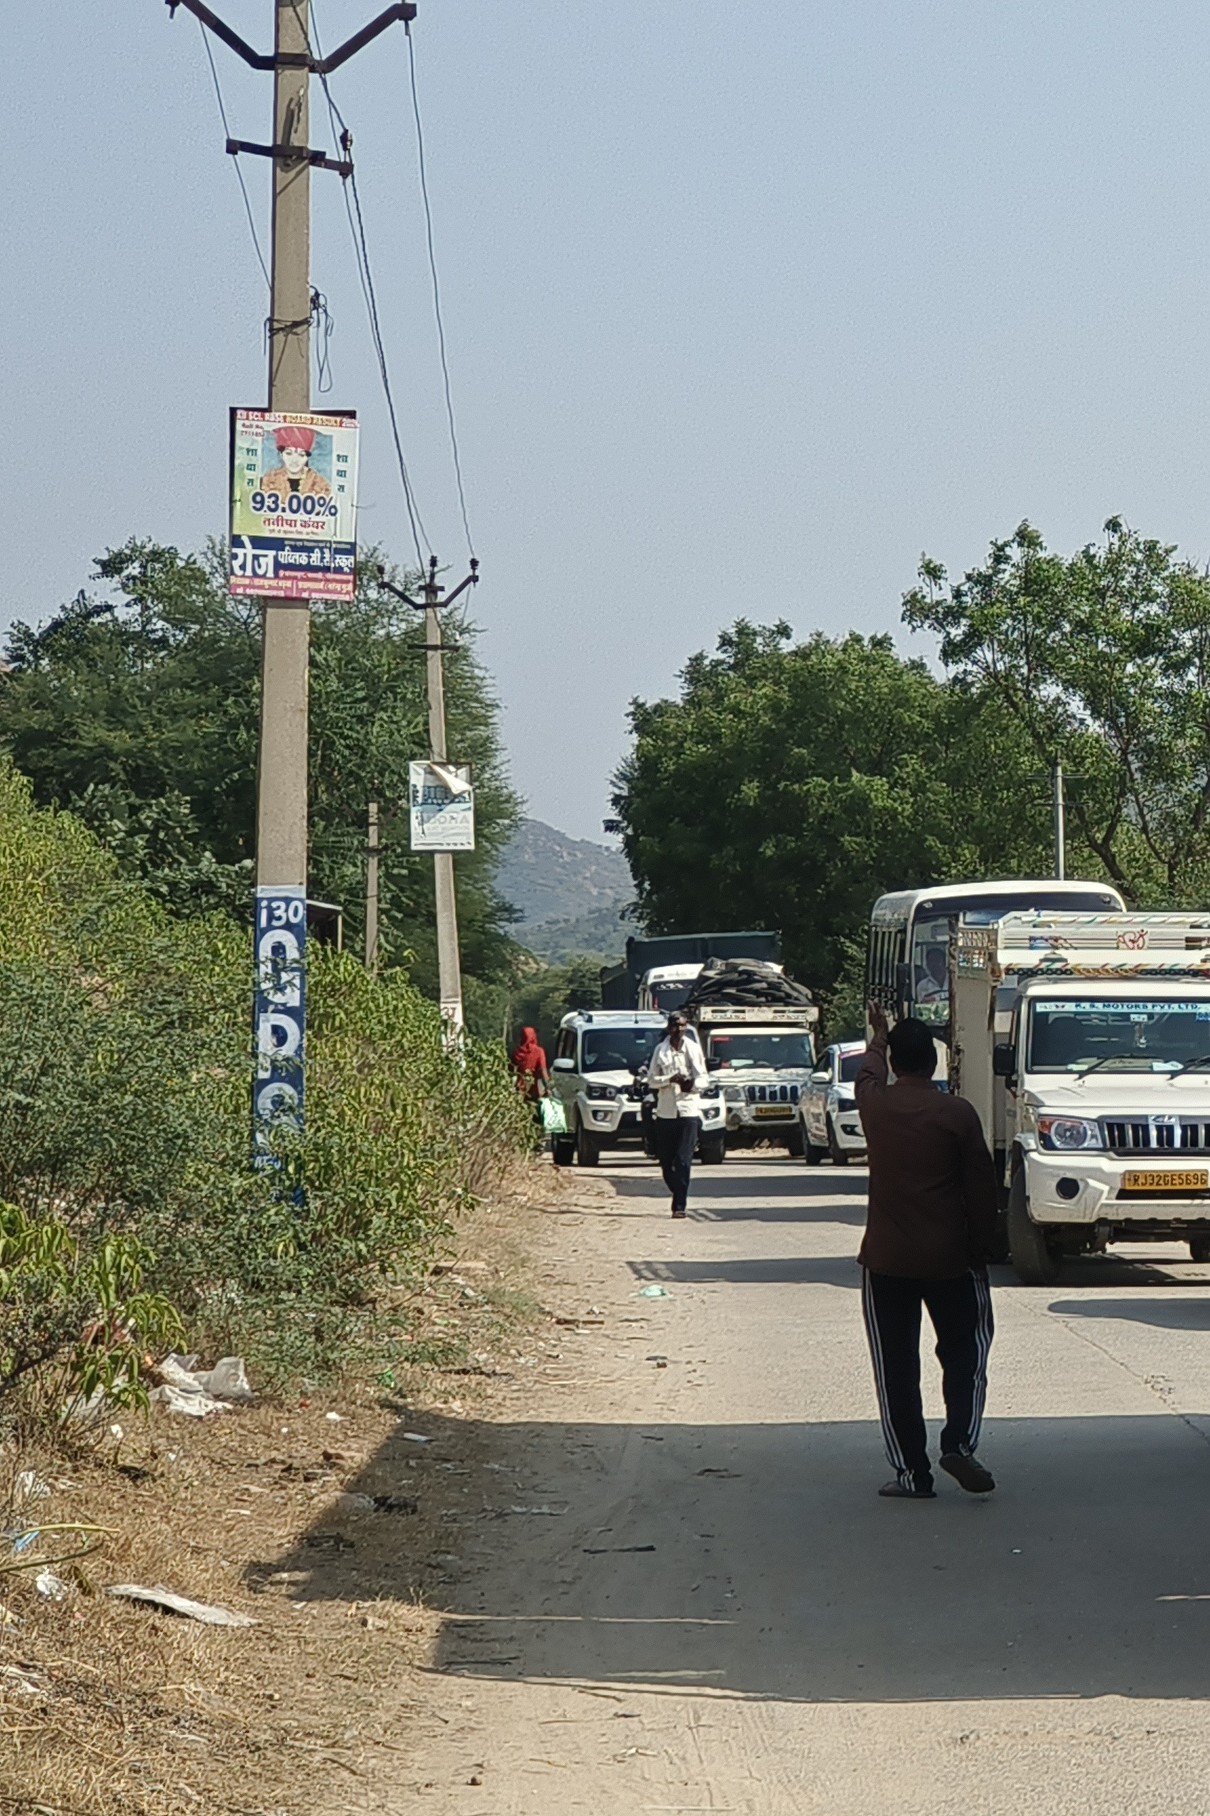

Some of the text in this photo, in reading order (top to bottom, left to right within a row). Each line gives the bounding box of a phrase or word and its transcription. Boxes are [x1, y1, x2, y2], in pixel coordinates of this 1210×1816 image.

[251, 492, 339, 518] 93.00%
[231, 537, 277, 579] रोज
[1132, 1172, 1208, 1187] RJ32GE5696
